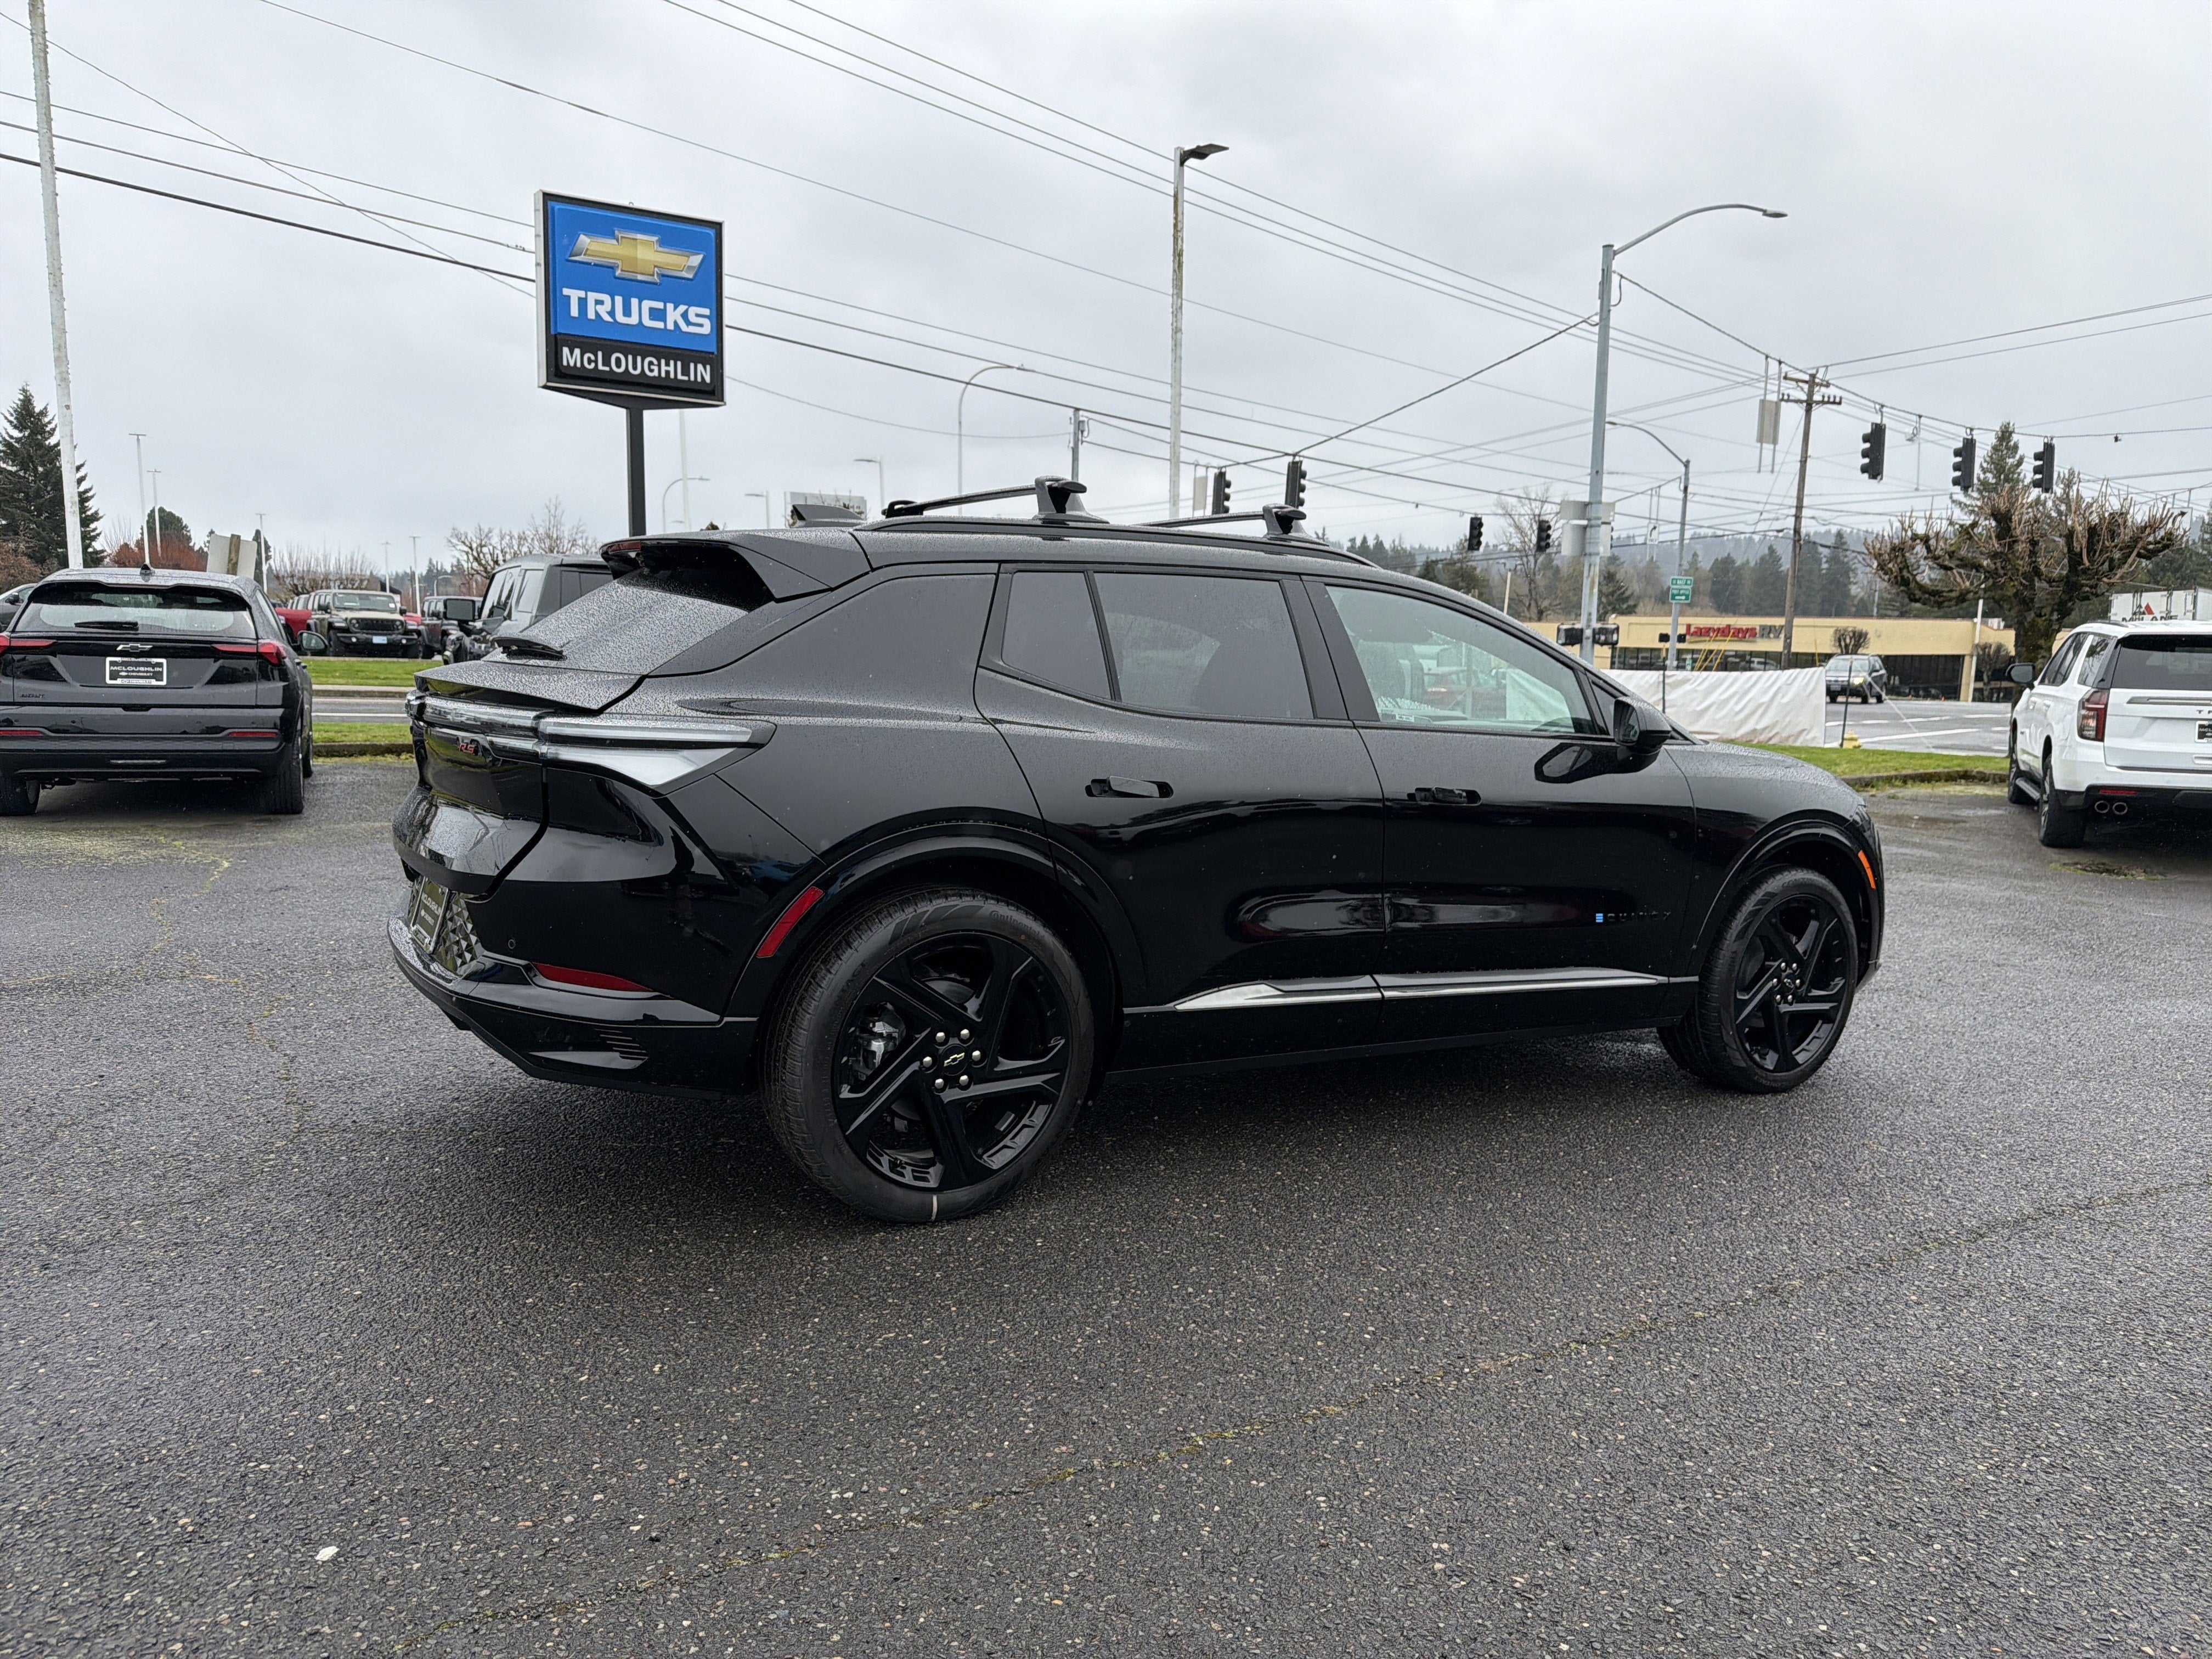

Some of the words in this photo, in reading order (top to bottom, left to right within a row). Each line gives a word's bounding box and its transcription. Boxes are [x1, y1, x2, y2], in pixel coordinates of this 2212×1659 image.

[562, 287, 711, 335] TRUCKS
[562, 346, 711, 384] McLOUGHLIN
[1685, 623, 1757, 639] Lazydays
[1759, 624, 1785, 639] RV
[458, 742, 475, 754] RS
[990, 910, 1042, 938] Continental
